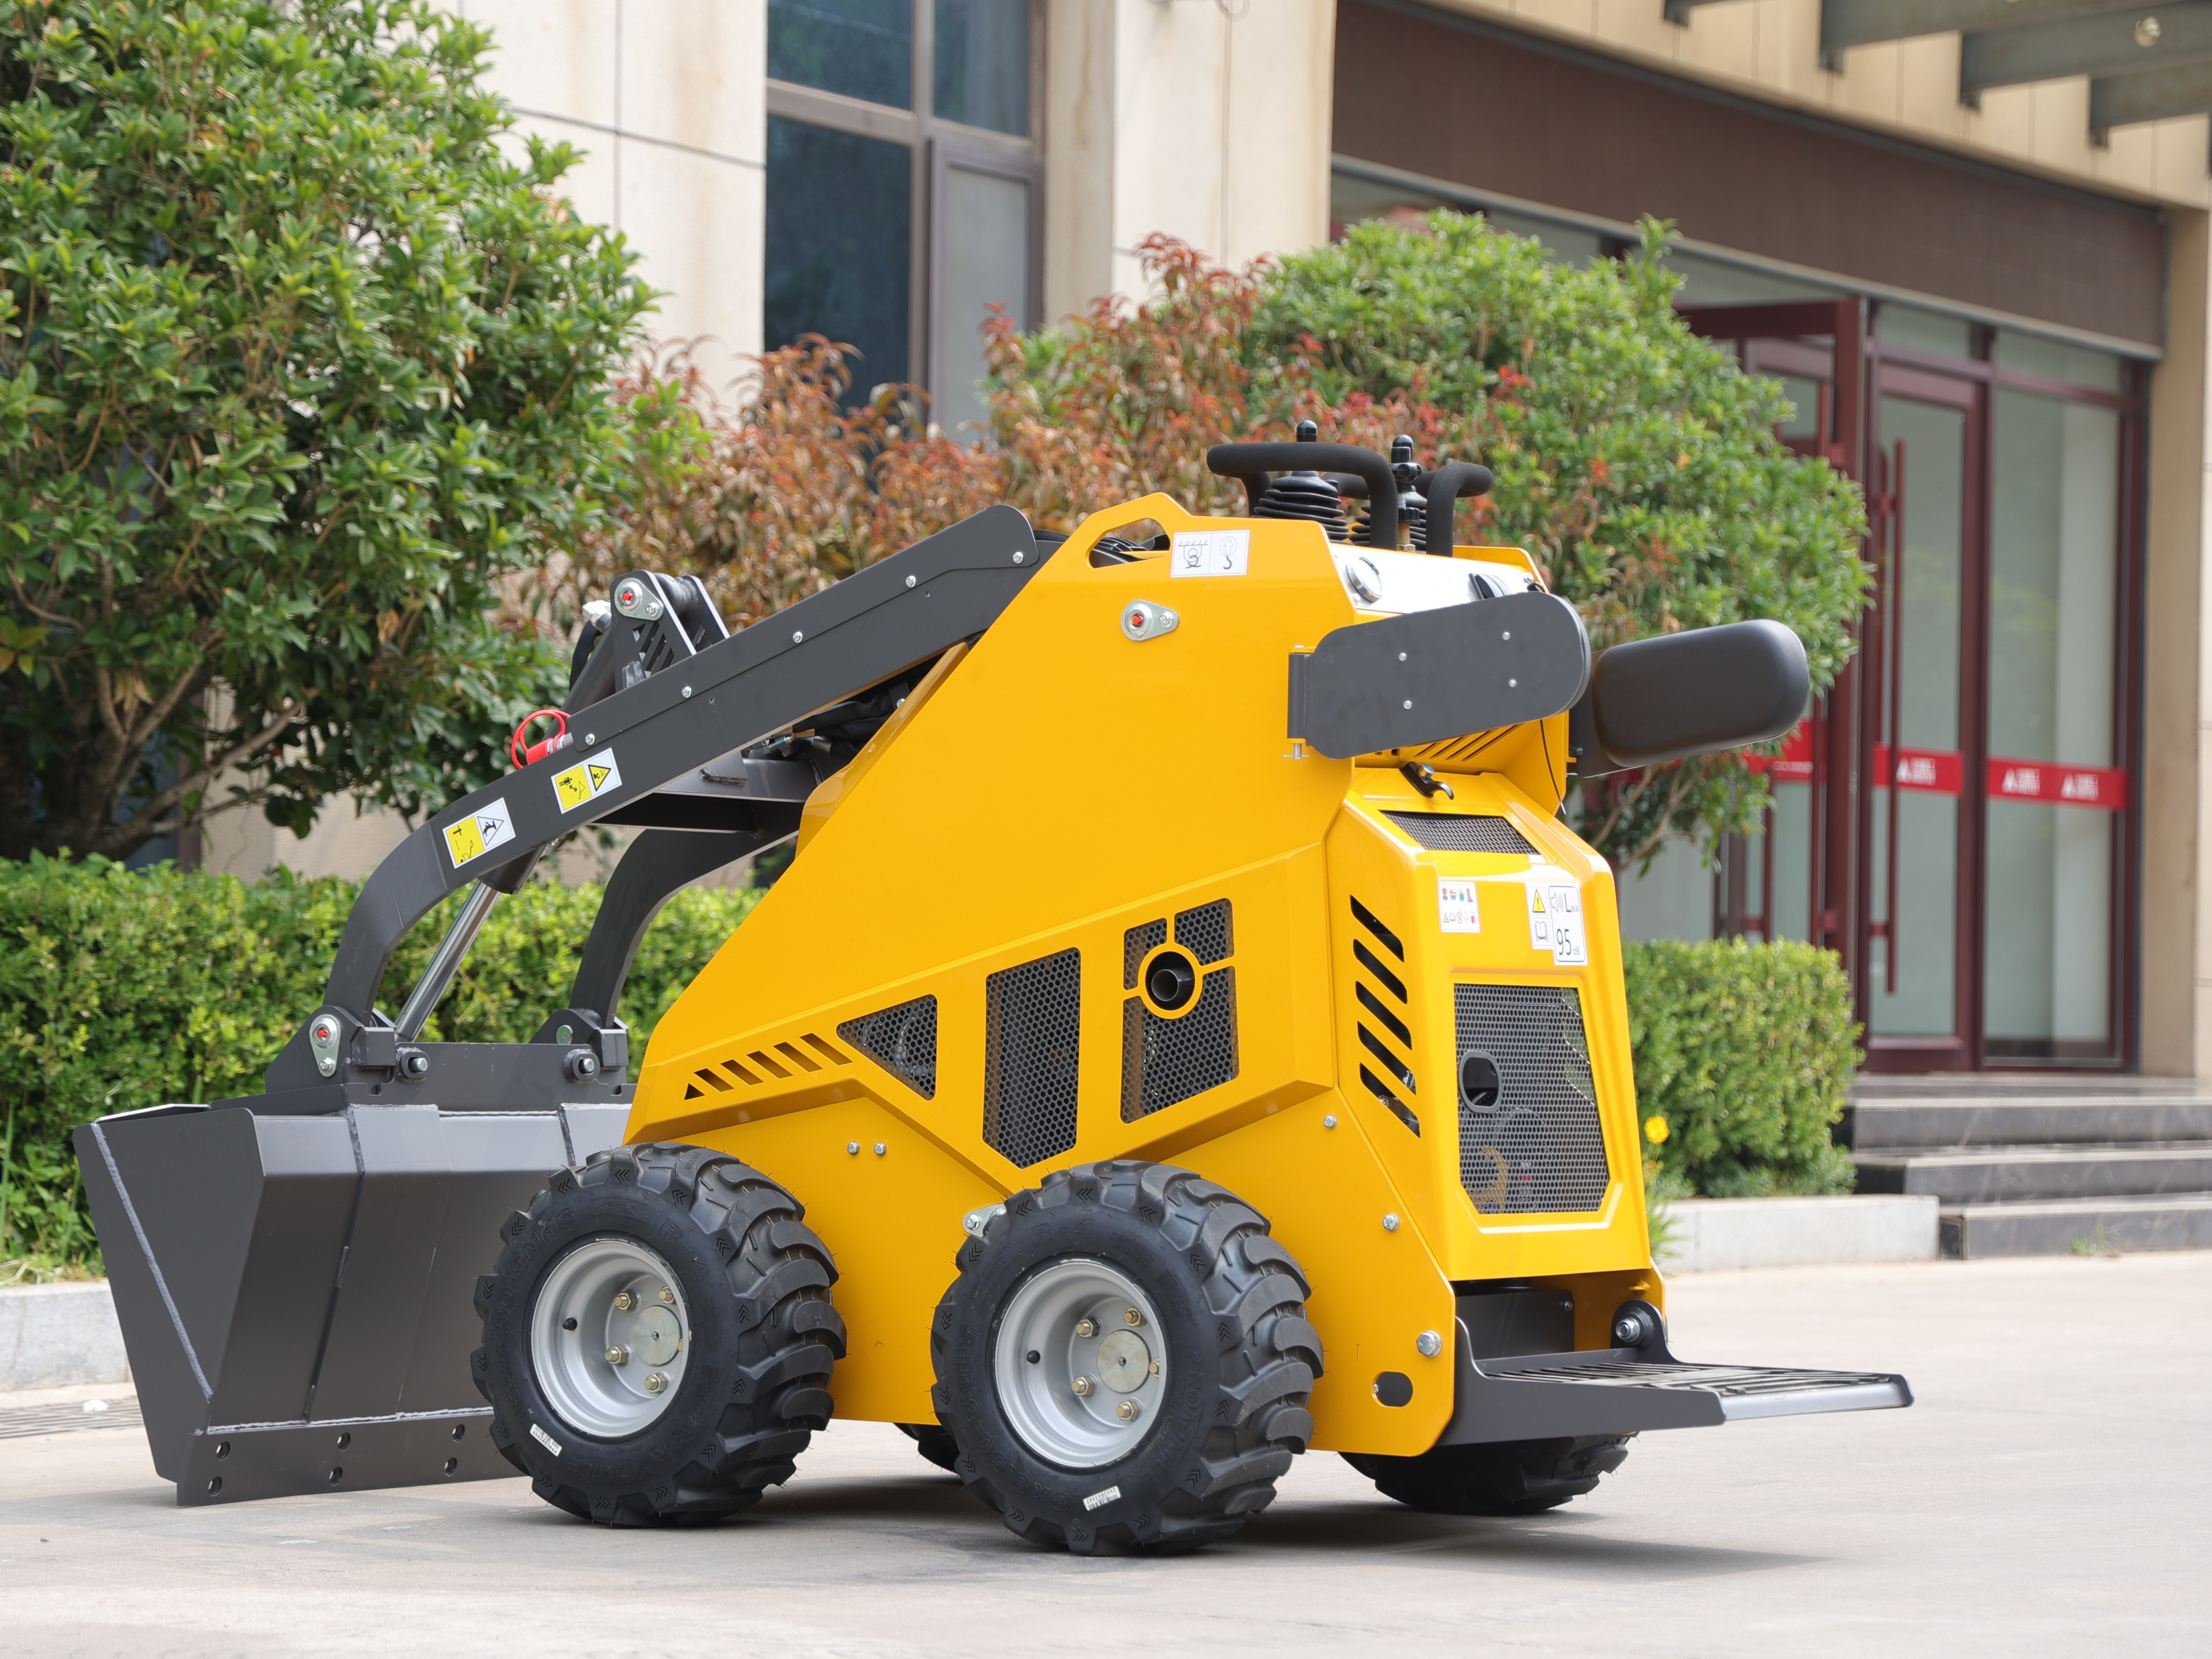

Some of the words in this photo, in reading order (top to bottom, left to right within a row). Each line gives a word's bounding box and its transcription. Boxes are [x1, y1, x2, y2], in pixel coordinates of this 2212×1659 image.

[1557, 929, 1571, 955] 95
[1573, 946, 1580, 955] dB
[1031, 1218, 1094, 1247] R-4
[659, 1217, 710, 1281] R-4
